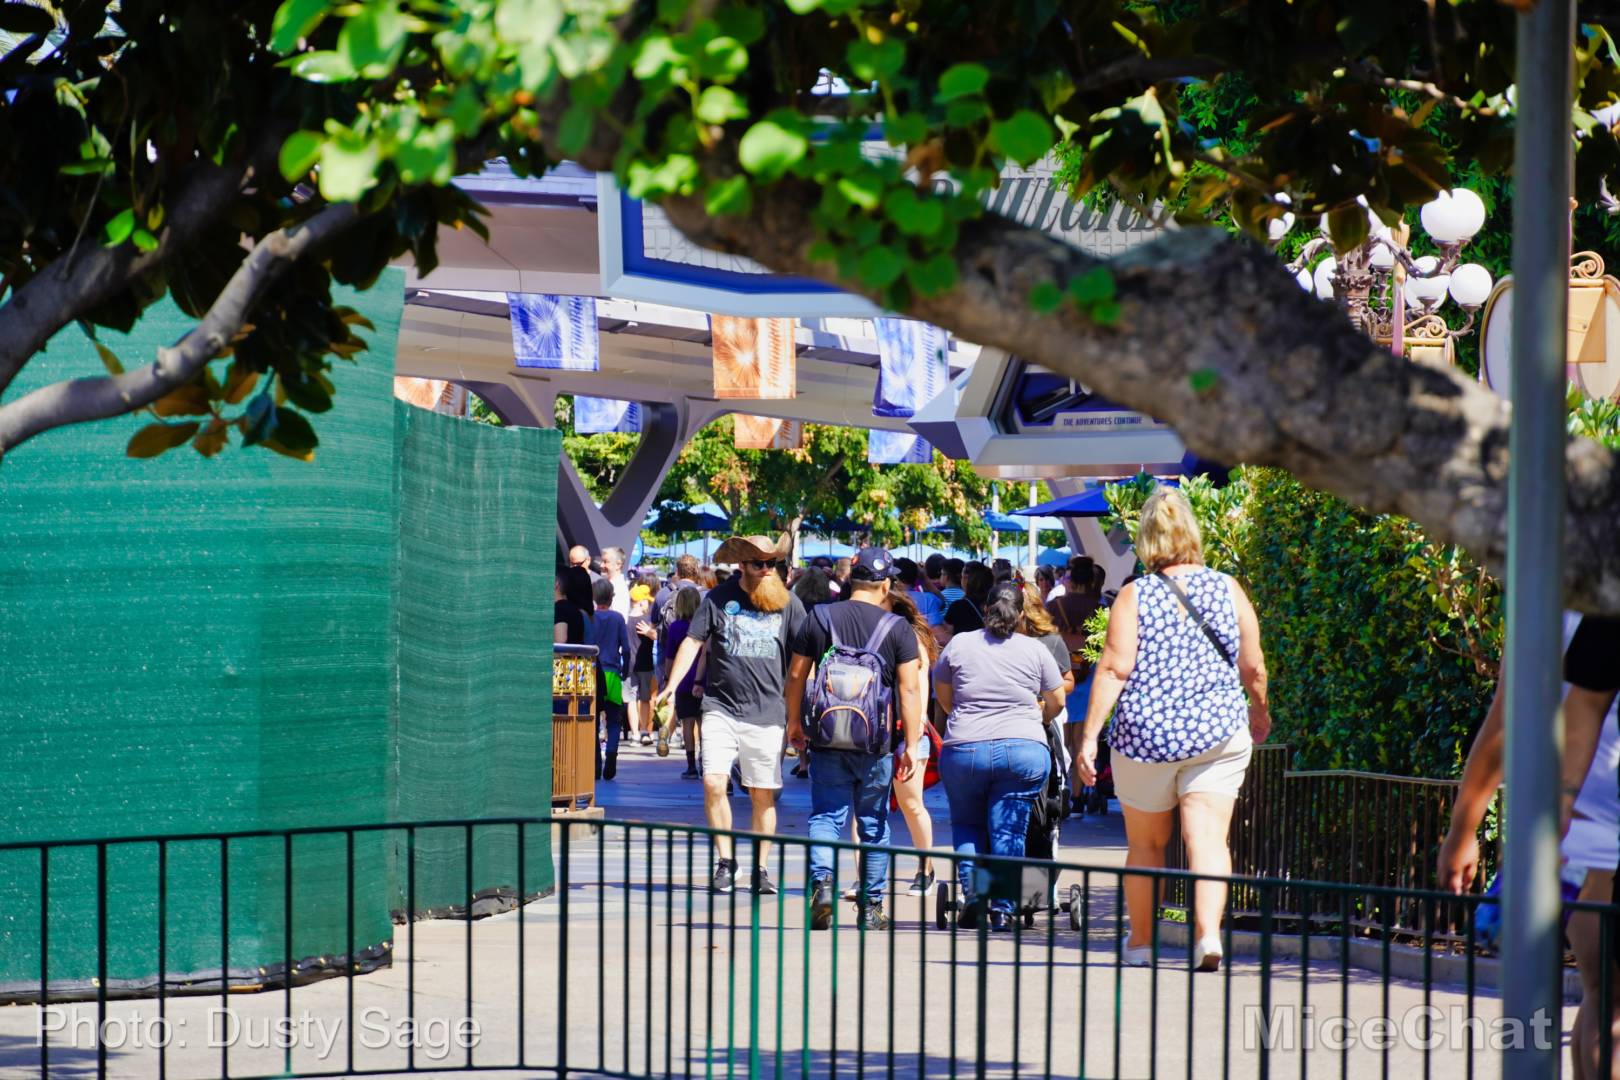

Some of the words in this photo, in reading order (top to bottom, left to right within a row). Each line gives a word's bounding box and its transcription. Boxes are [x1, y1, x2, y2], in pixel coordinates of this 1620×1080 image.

[1063, 417, 1073, 426] THE
[1075, 416, 1112, 425] ADVENTURES
[1114, 415, 1142, 425] CONTINUE
